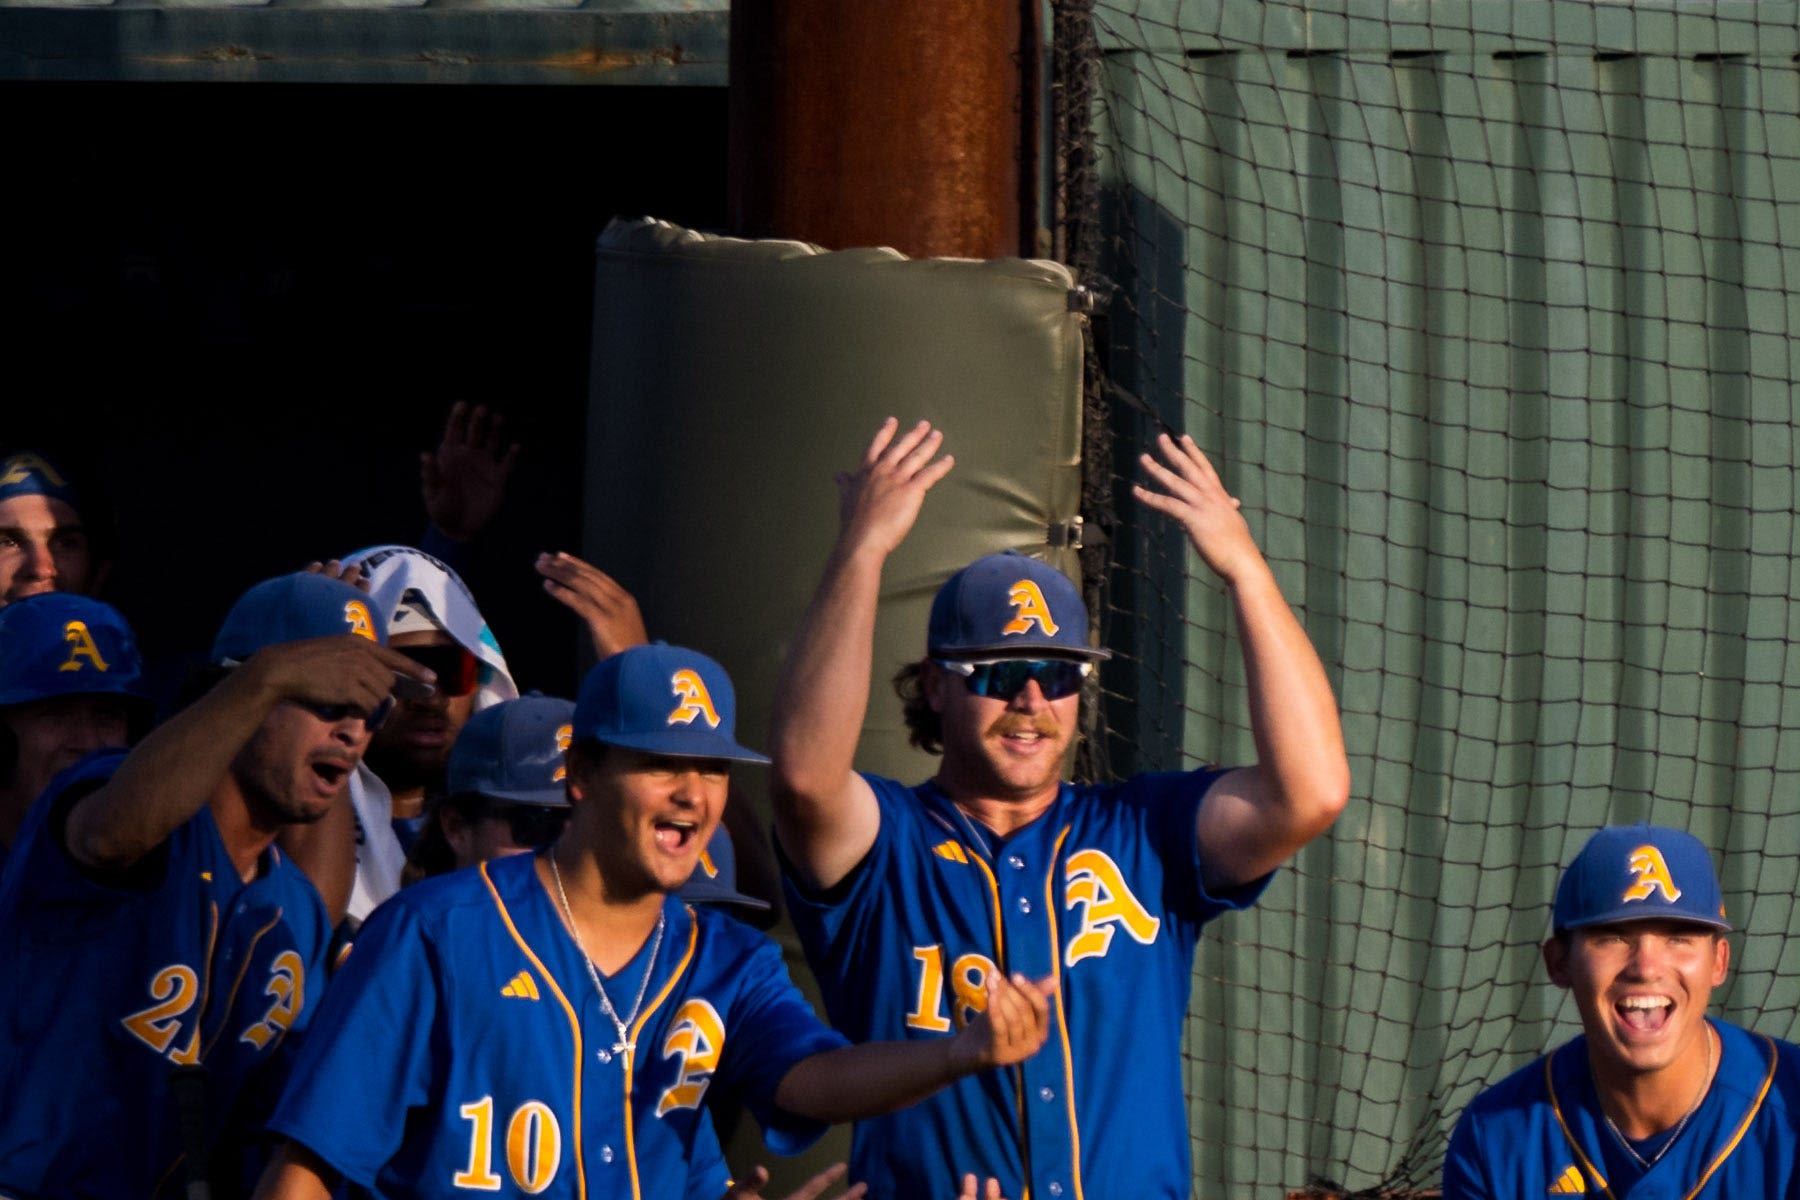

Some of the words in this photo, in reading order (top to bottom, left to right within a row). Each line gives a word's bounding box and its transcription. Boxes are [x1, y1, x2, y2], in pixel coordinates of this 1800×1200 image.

[1002, 579, 1060, 637] A
[58, 620, 110, 672] A
[666, 667, 721, 728] A
[1064, 848, 1160, 968] A
[1622, 843, 1682, 904] A
[906, 943, 998, 1033] 18
[655, 998, 726, 1119] A
[453, 1094, 561, 1194] 10
